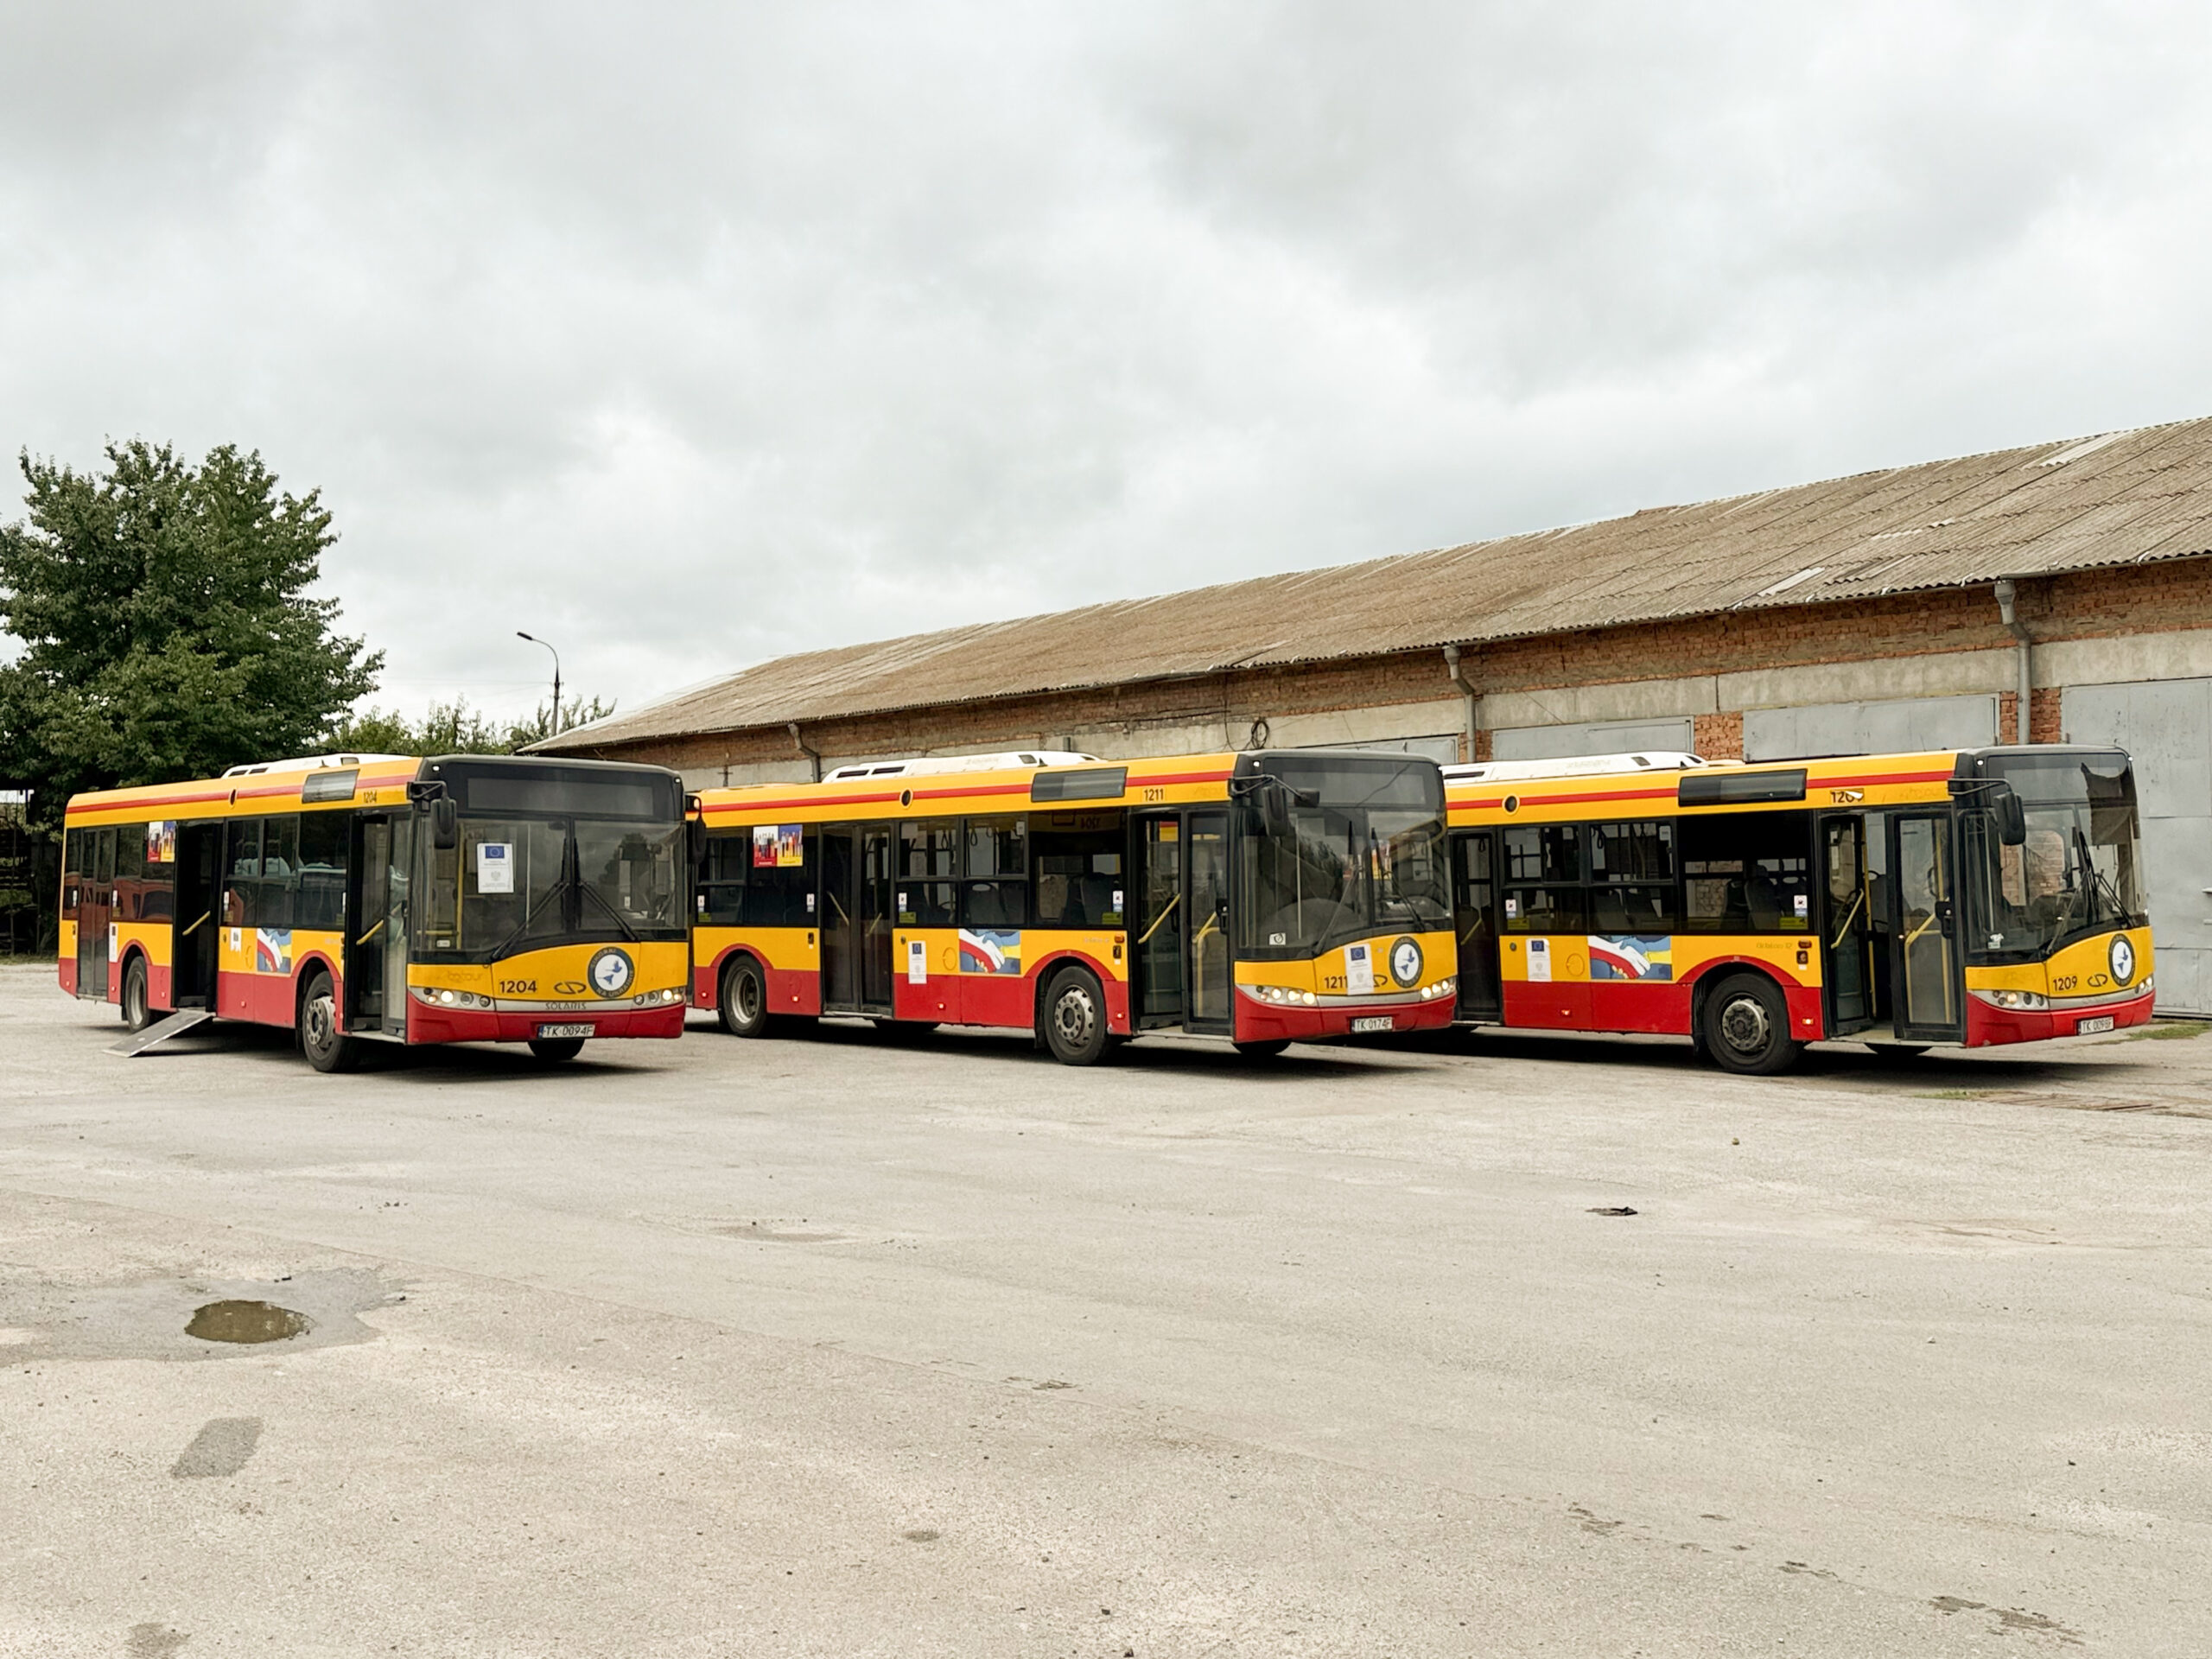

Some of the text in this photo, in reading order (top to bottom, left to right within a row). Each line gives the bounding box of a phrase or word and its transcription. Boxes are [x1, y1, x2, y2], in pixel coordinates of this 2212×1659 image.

[363, 790, 378, 804] 1204
[1143, 788, 1164, 802] 1211
[1830, 790, 1865, 804] 120
[499, 980, 537, 994] 1204
[1324, 976, 1348, 989] 1211
[2053, 976, 2078, 992] 1209
[546, 1026, 594, 1036] TK 0094F
[1356, 1020, 1366, 1030] TK
[2082, 1020, 2092, 1032] TK
